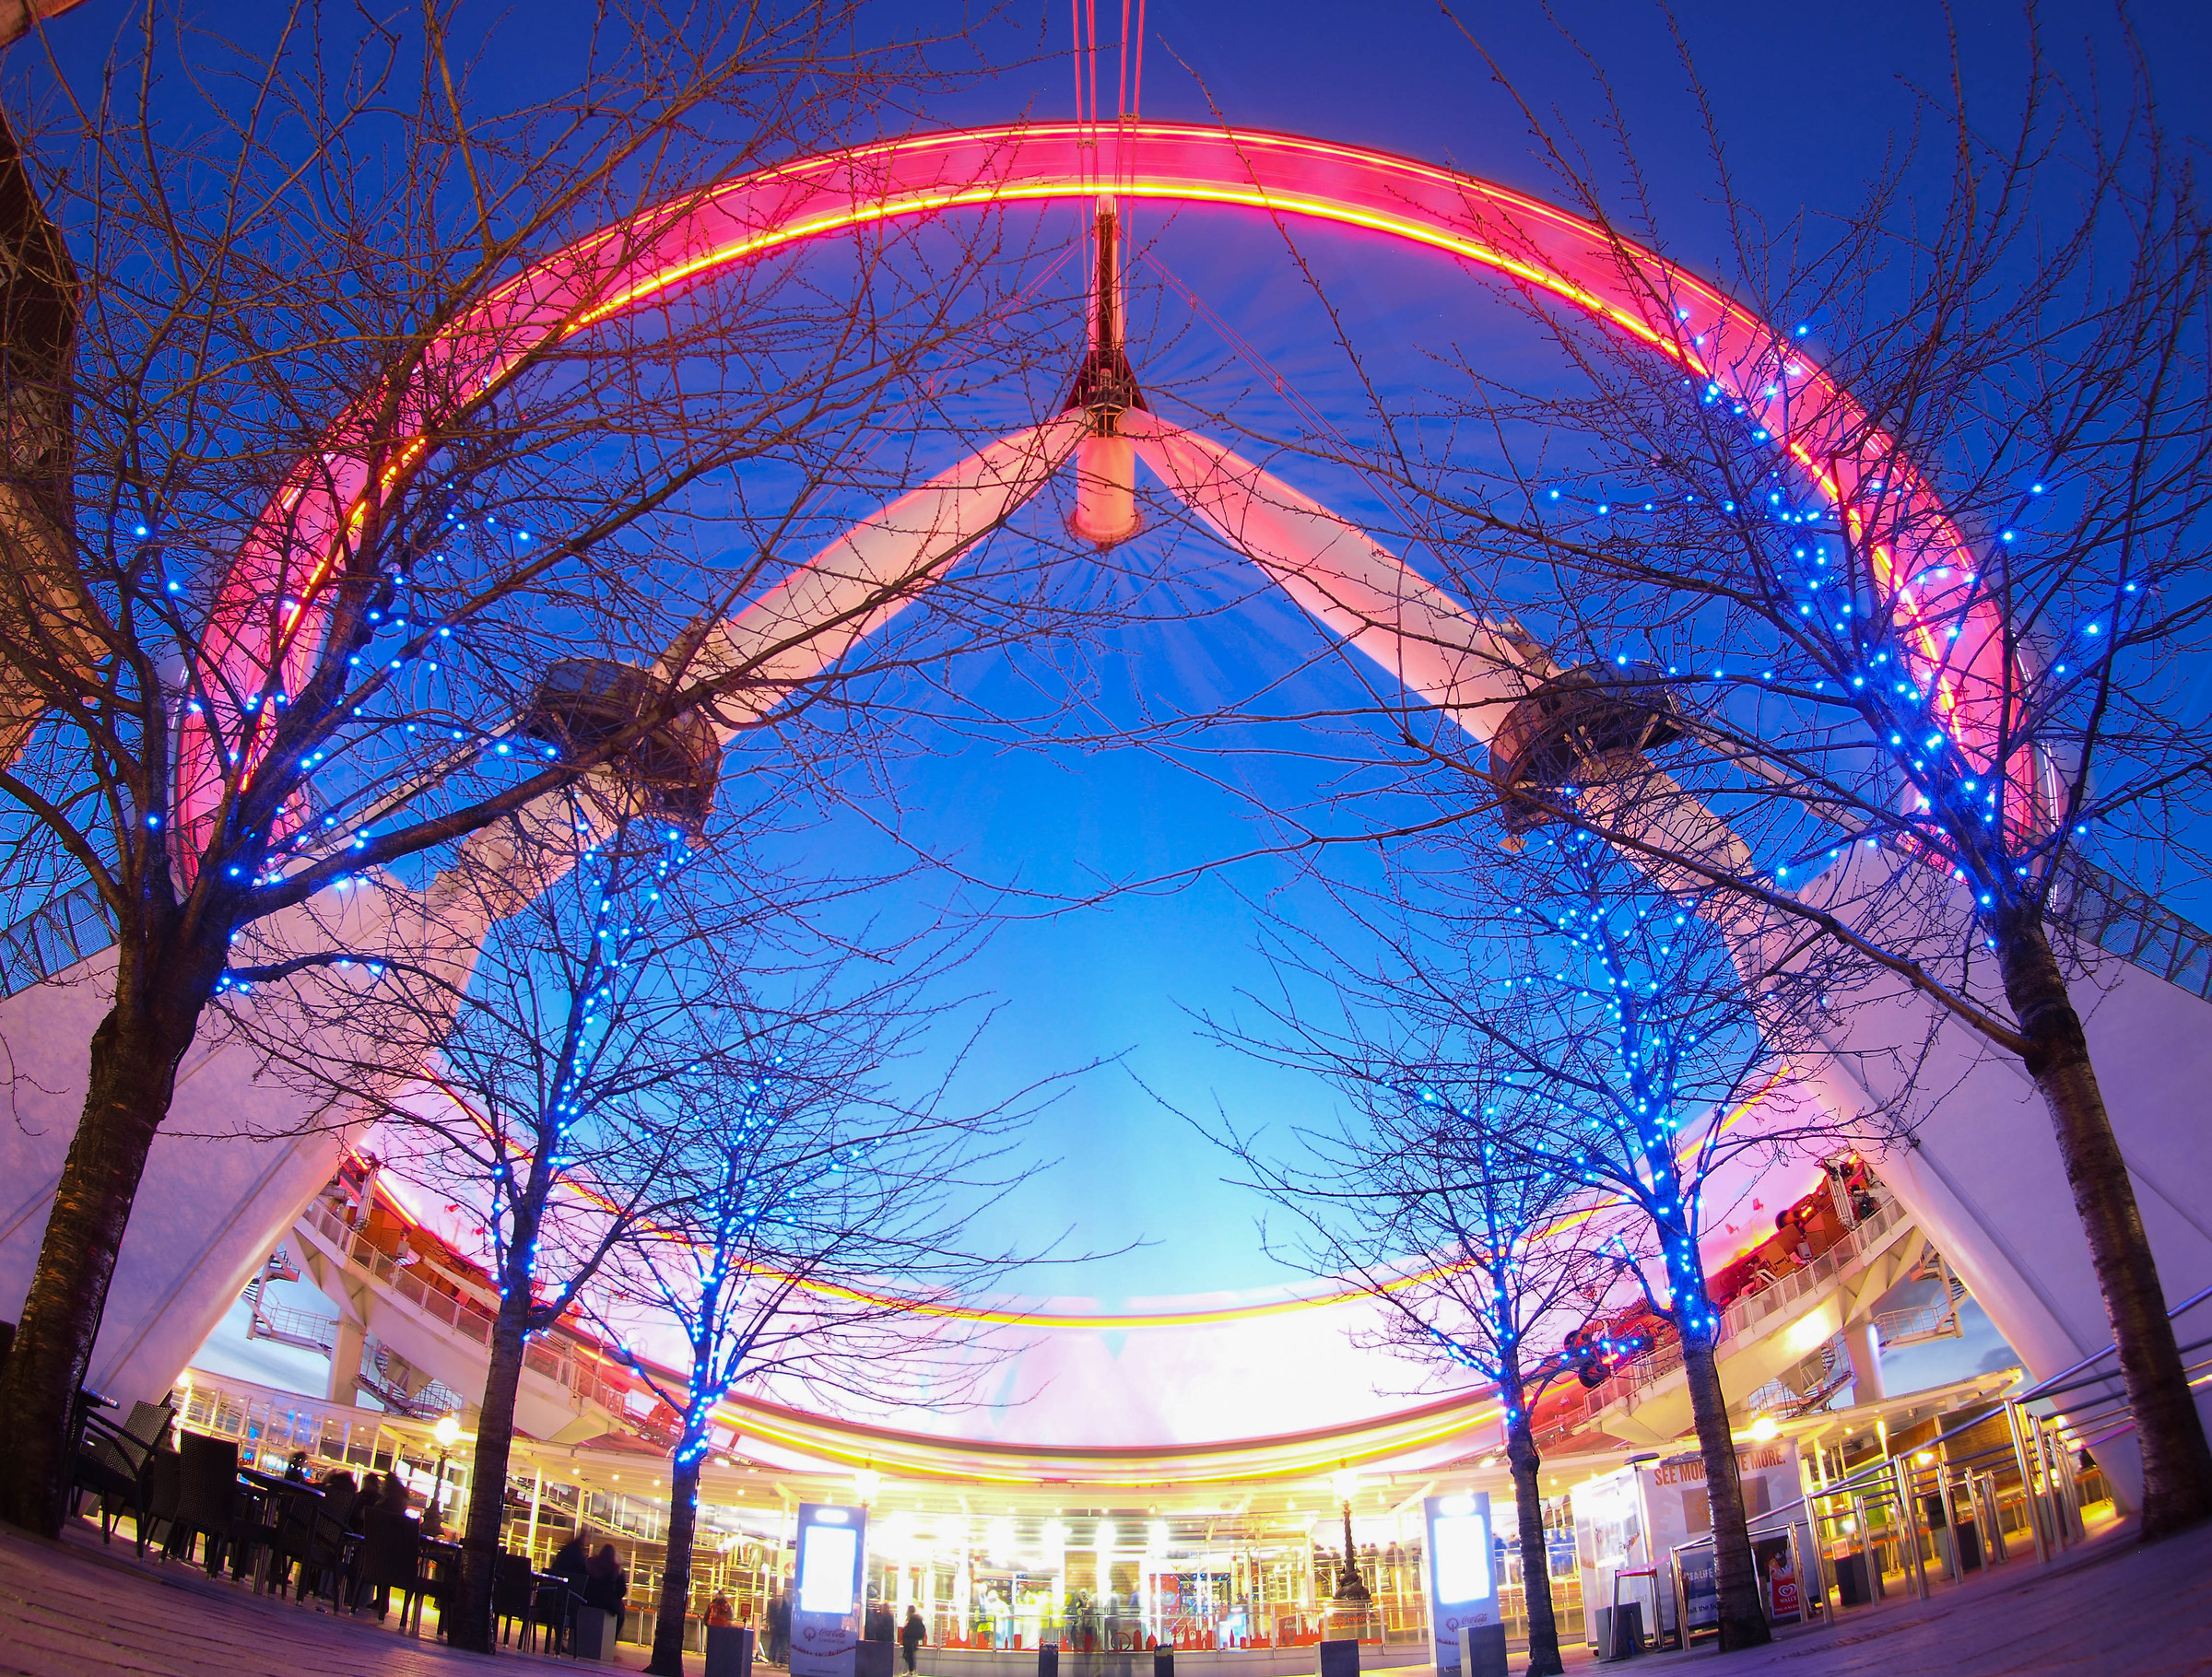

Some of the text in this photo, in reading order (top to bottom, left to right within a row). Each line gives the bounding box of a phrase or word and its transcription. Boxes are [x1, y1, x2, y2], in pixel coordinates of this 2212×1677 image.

[1654, 1465, 1677, 1485] SEE
[1679, 1461, 1706, 1483] MOR
[1751, 1448, 1785, 1470] MORE.
[1700, 1567, 1713, 1579] LIFE
